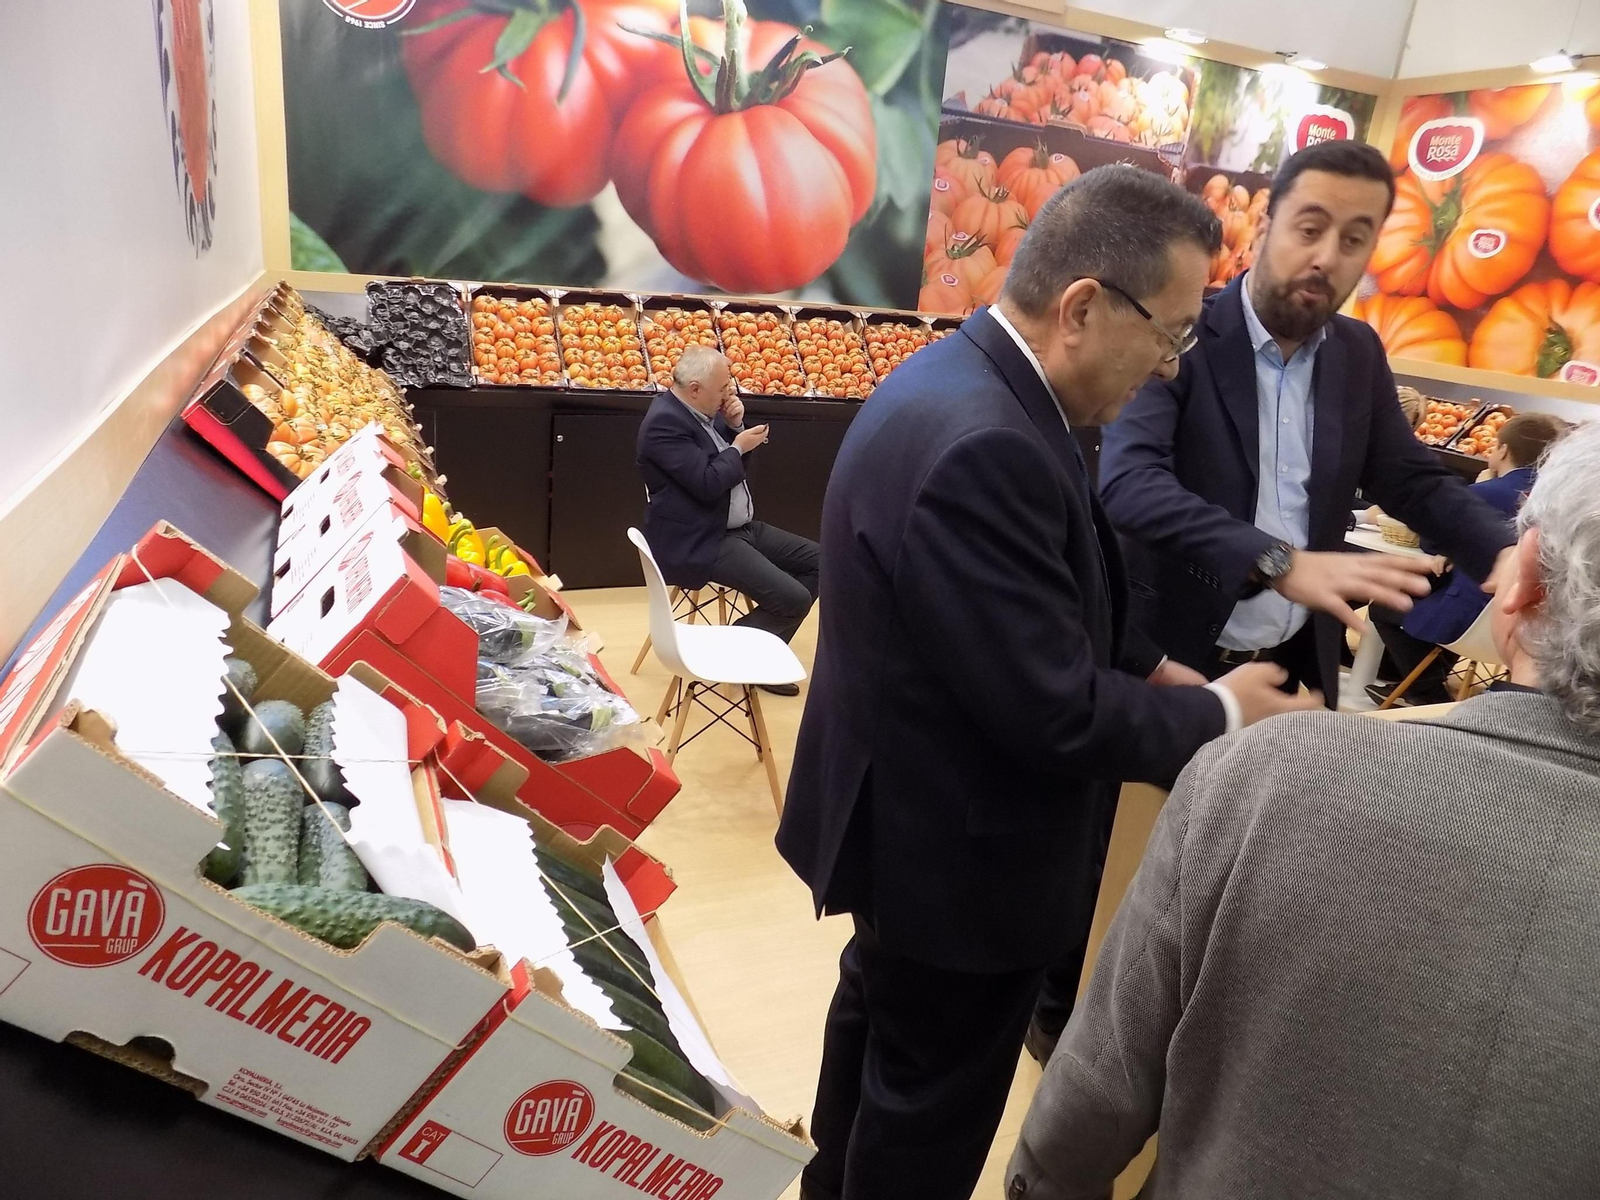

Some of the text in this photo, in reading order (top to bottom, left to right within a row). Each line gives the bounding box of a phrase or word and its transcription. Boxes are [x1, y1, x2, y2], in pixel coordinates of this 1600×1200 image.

[364, 21, 386, 29] SINCE
[1308, 123, 1337, 140] Monte
[1429, 134, 1463, 146] Monte
[106, 938, 138, 954] GRUP
[138, 926, 372, 1065] KOPALMERIA
[421, 1127, 446, 1142] CAT
[552, 1132, 575, 1145] GRUP
